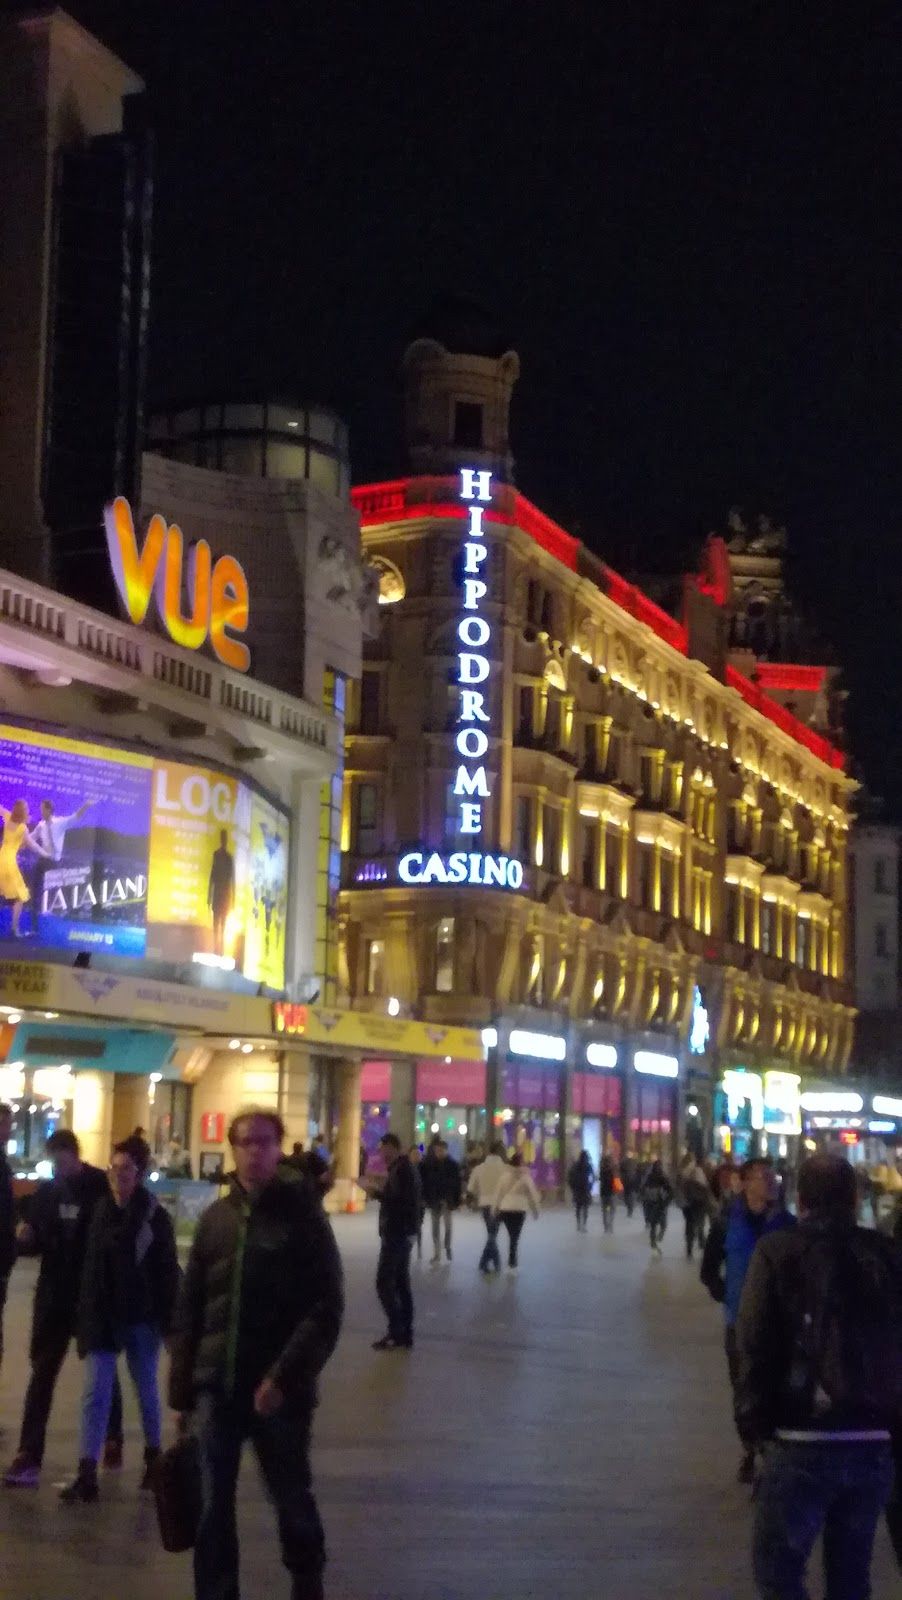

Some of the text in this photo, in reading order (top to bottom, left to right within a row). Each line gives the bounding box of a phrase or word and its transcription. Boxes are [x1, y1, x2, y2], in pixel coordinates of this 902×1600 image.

[453, 468, 493, 834] HIPPODROME
[102, 873, 147, 904] LAND
[398, 851, 524, 890] CASINO
